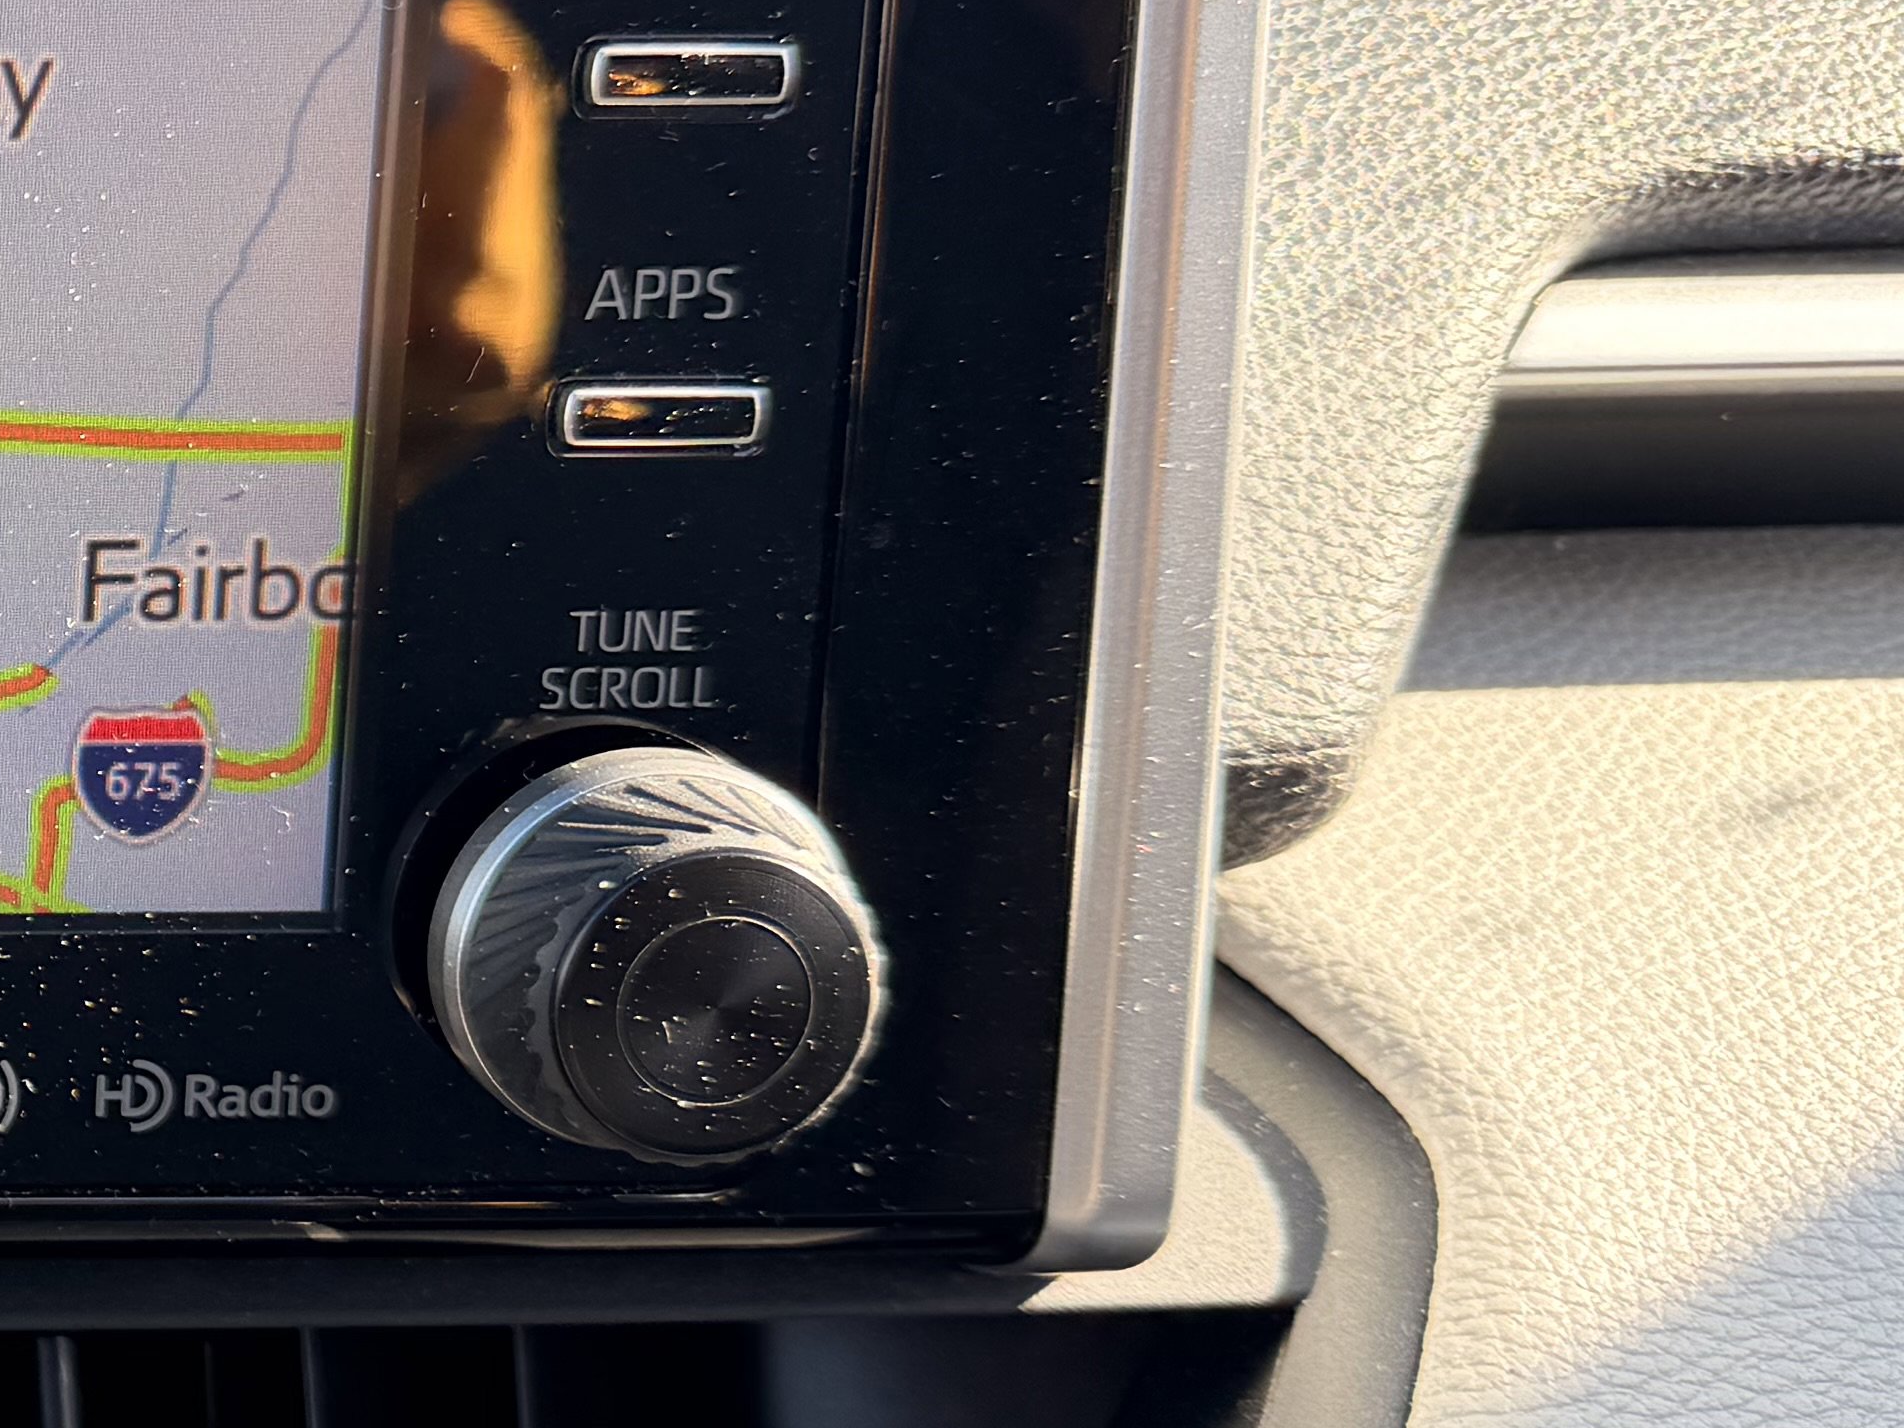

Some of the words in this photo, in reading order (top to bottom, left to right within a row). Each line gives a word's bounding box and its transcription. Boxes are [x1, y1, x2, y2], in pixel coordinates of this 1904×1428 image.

[584, 265, 739, 321] APPS
[569, 607, 700, 654] TUNE
[538, 665, 715, 711] SCROLL
[104, 760, 184, 803] 675
[184, 1071, 336, 1121] Radio
